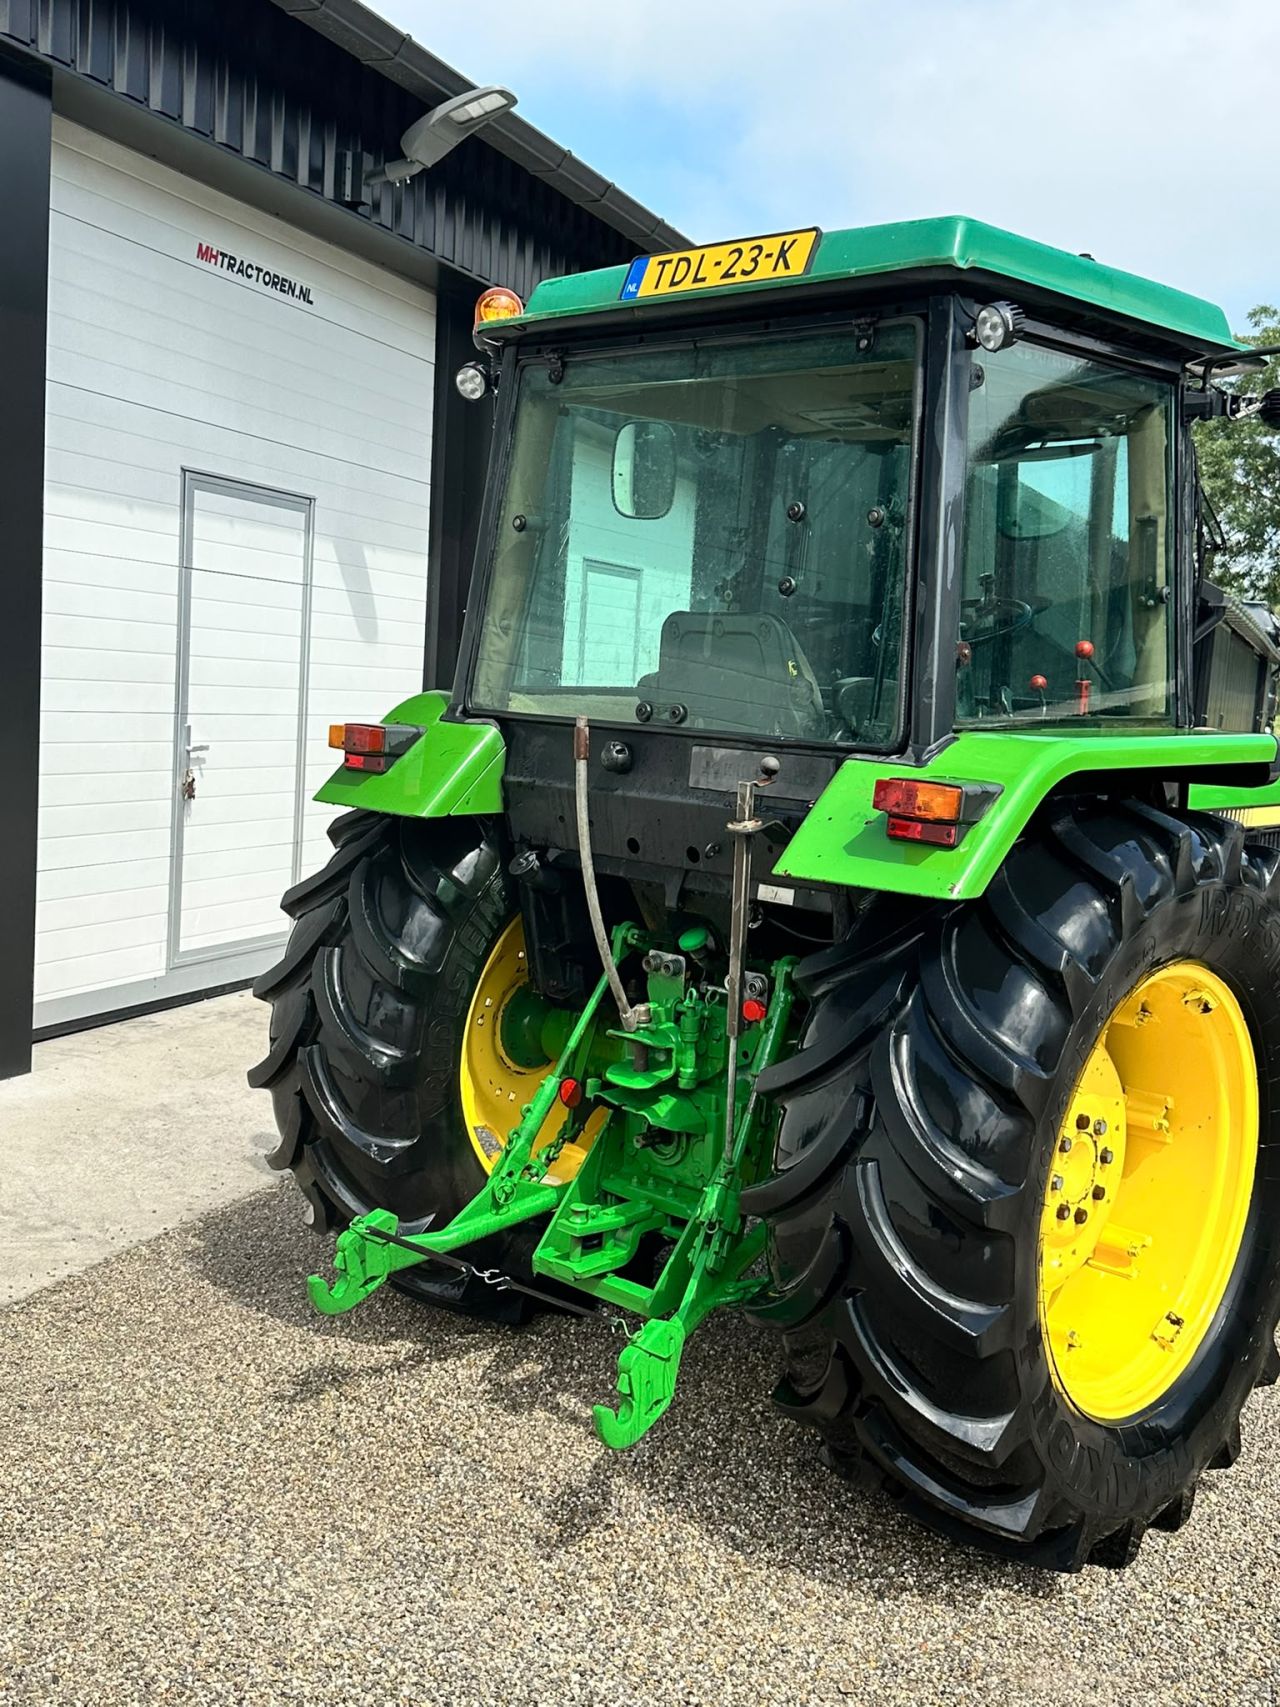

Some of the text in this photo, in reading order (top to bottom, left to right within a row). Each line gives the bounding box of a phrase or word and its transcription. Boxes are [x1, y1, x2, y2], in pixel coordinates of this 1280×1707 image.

[196, 242, 314, 305] MHTRACTOREN.NL
[626, 239, 798, 293] NL TDL-23-K
